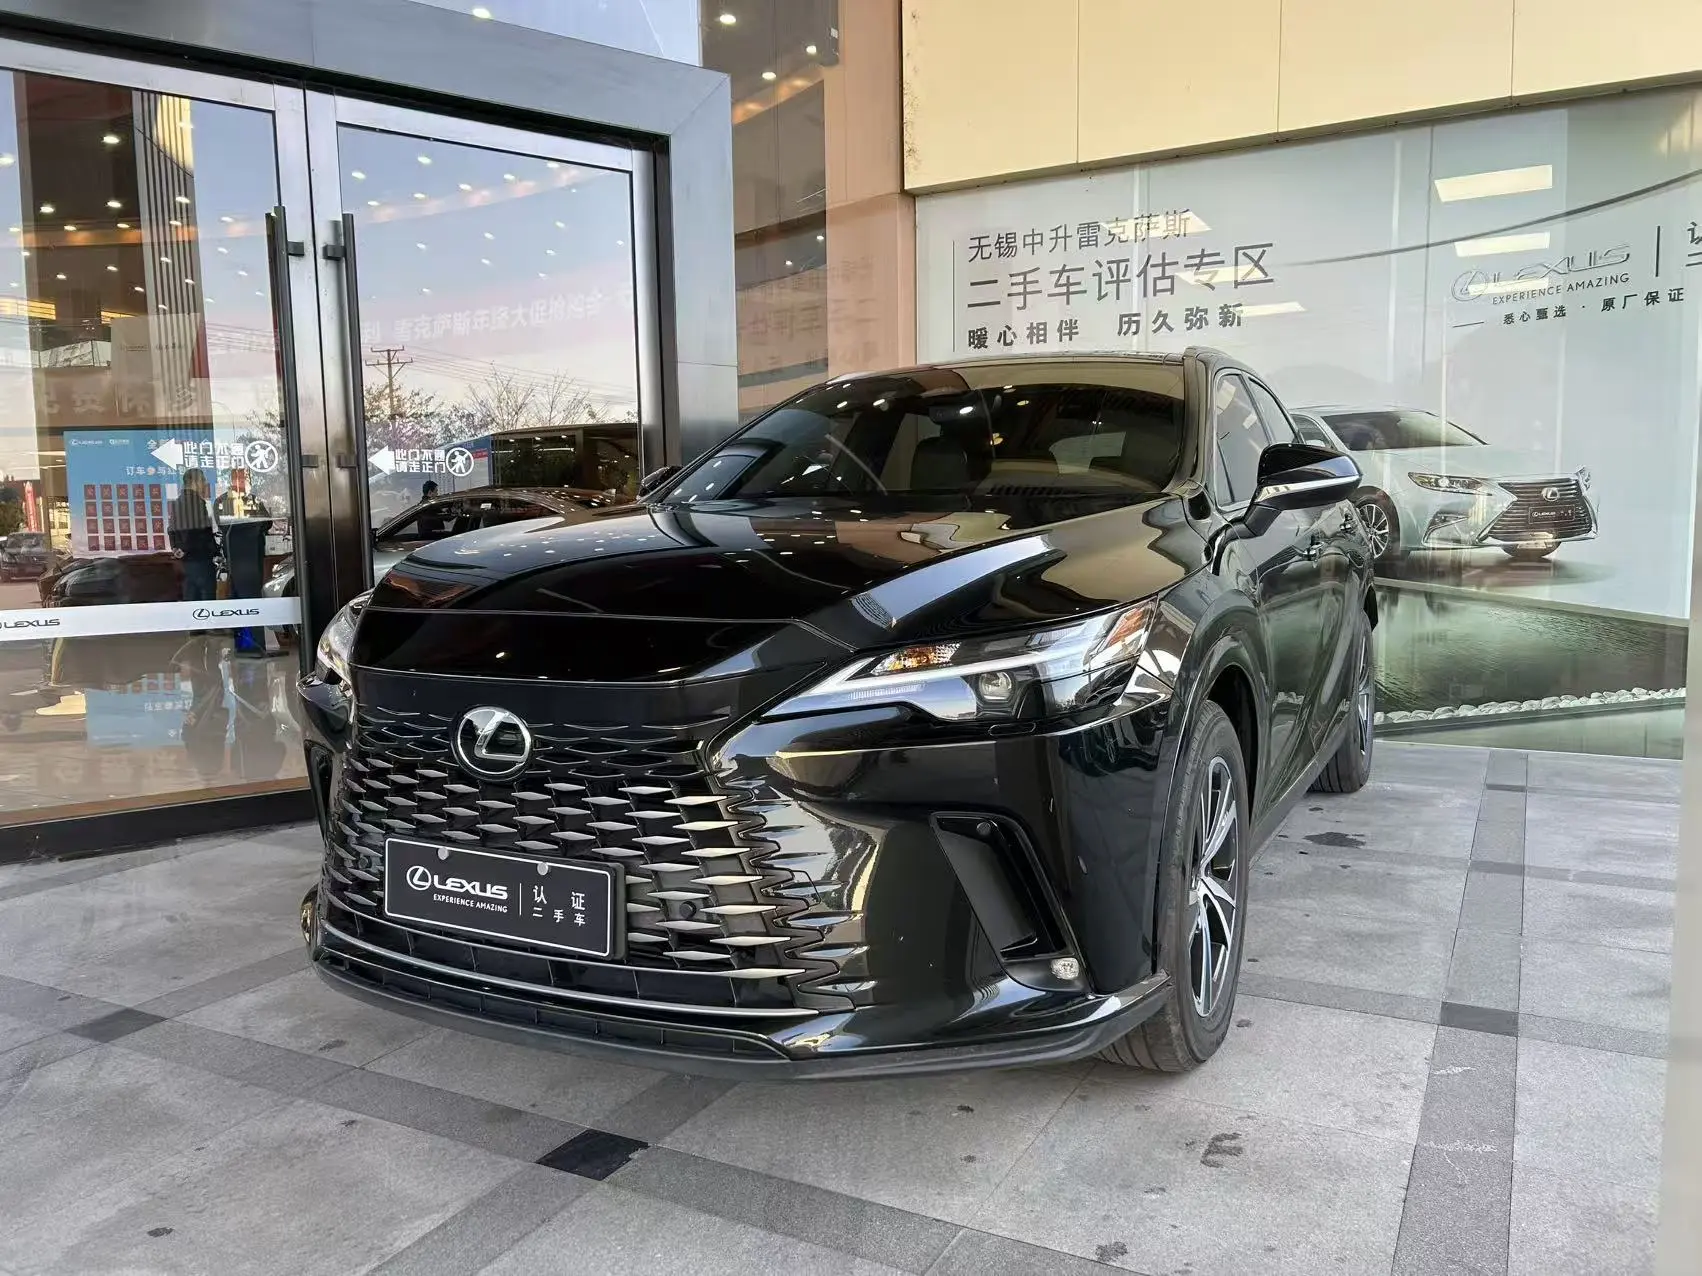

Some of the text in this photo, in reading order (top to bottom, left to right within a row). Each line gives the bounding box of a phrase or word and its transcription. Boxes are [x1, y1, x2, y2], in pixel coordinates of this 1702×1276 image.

[968, 208, 1191, 263] 无锡中升雷克萨斯
[967, 242, 1275, 311] 二手车评估专区
[1493, 243, 1631, 287] LEXUS
[1492, 272, 1630, 305] EXPERIENCE AMAZING
[1503, 287, 1685, 325] 悉心甄选 原厂保证
[967, 302, 1243, 351] 暖心相伴 历久弥新
[183, 441, 244, 455] 此门不通
[394, 449, 446, 461] 此门不通
[184, 454, 245, 469] 请走正门
[395, 461, 446, 473] 请走正门
[3, 618, 60, 629] LEXUS
[211, 608, 260, 617] LEXUS
[433, 874, 508, 900] LEXUS
[533, 885, 586, 911] 认证
[433, 893, 508, 914] EXPERIENCE AMAZING
[532, 907, 586, 927] 二手车
